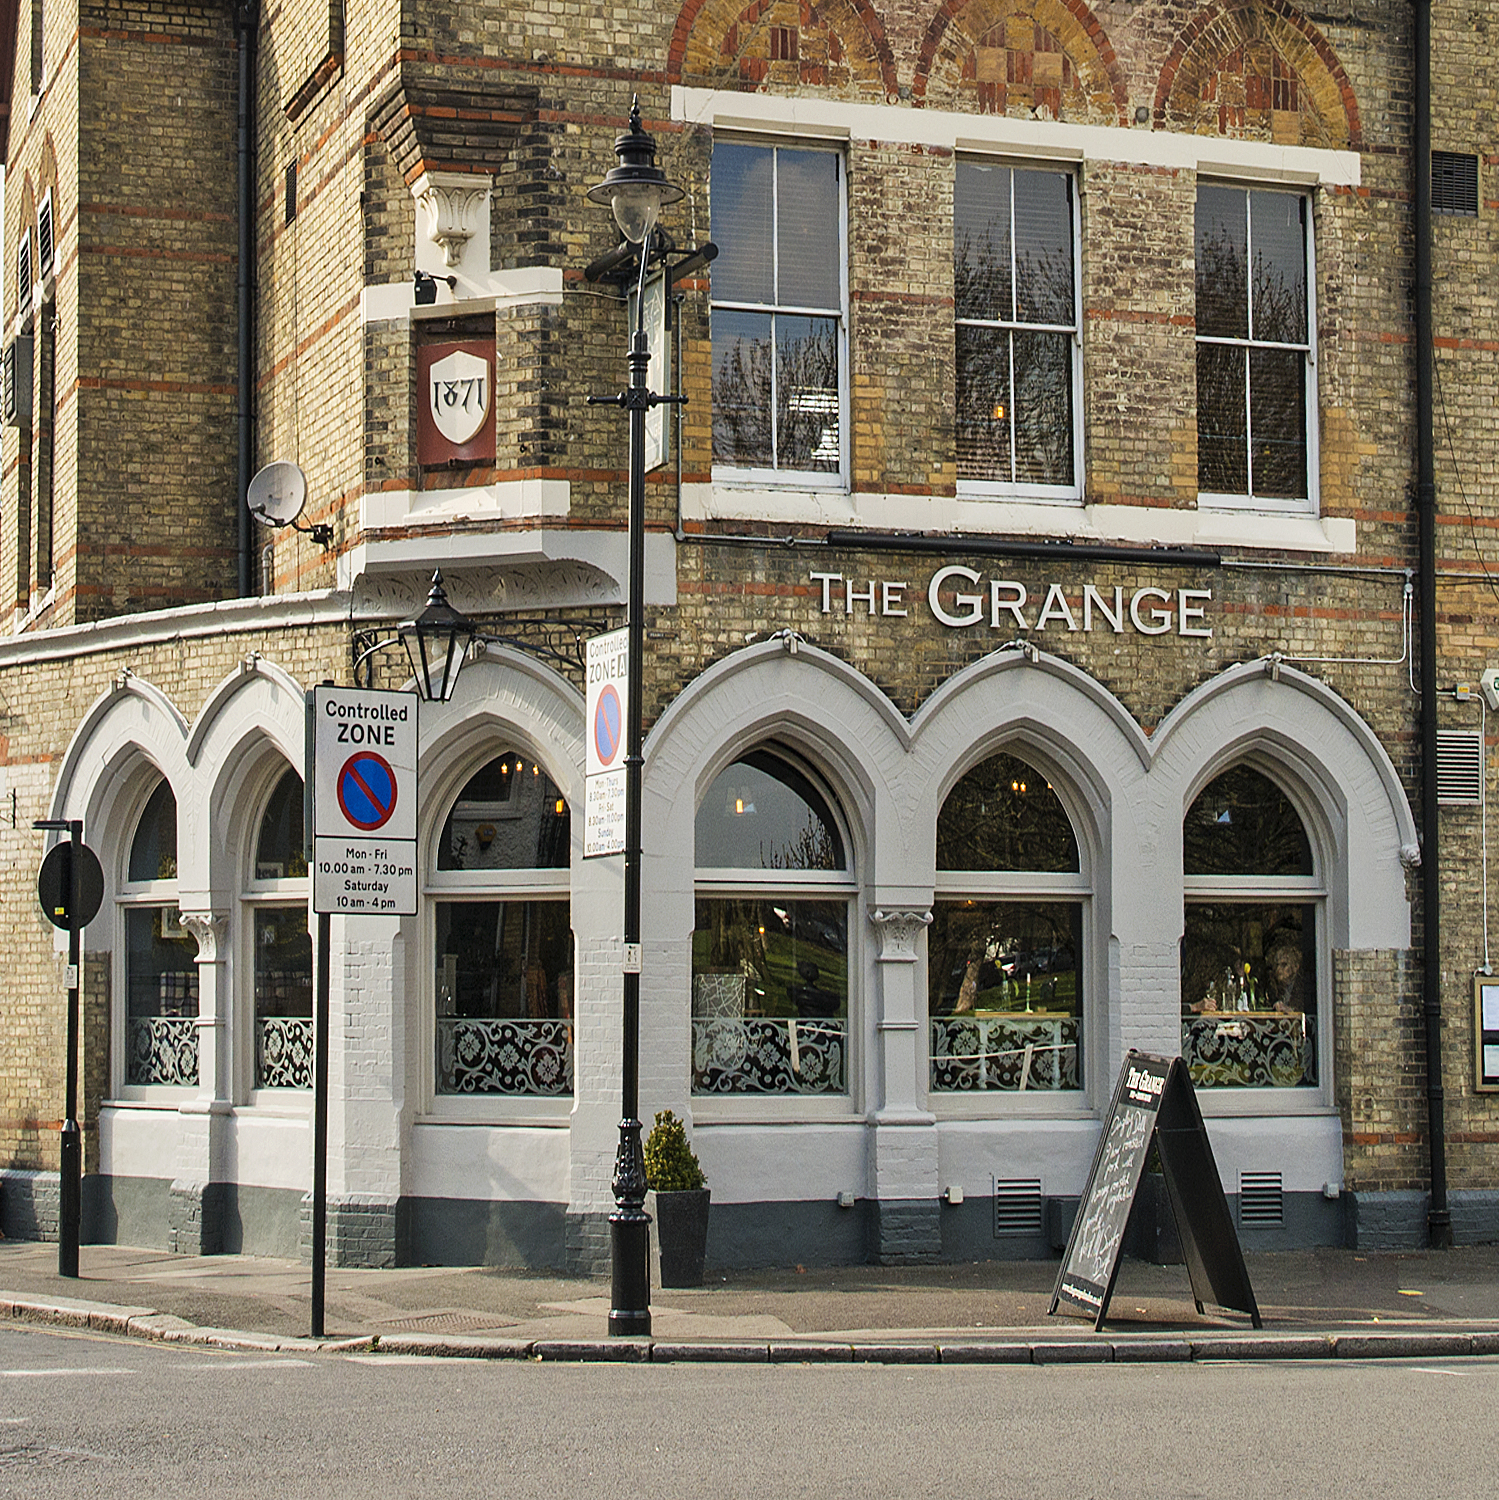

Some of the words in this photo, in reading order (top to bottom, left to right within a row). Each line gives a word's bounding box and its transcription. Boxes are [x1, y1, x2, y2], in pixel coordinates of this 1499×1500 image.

[433, 377, 485, 417] 1871
[809, 571, 908, 617] THE
[928, 565, 1214, 639] GRANGE
[590, 632, 628, 658] Controlled
[590, 658, 615, 684] ZONE
[618, 652, 627, 678] A
[326, 700, 408, 722] Controlled
[337, 723, 395, 746] ZONE
[346, 848, 367, 860] Mon
[375, 849, 388, 860] Fri
[319, 862, 349, 874] 10.00
[374, 864, 397, 875] 7.30
[398, 867, 413, 878] pm
[344, 880, 389, 893] Saturday
